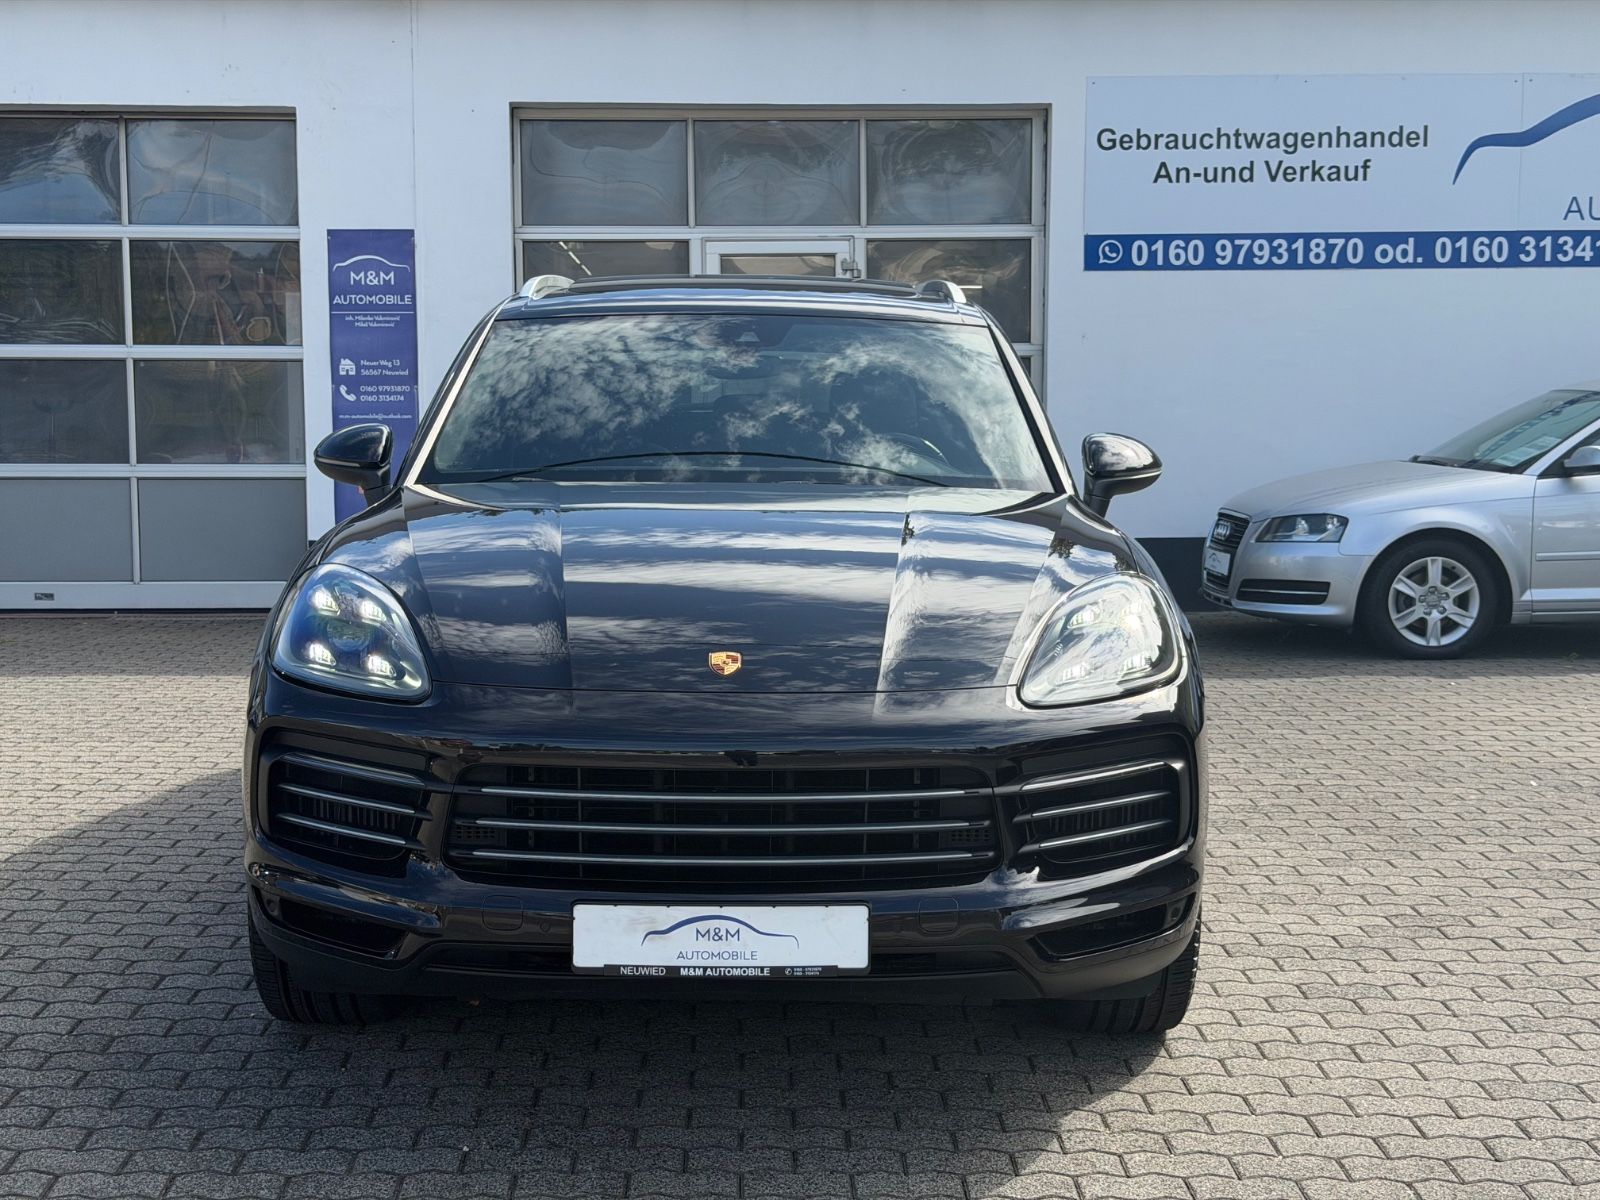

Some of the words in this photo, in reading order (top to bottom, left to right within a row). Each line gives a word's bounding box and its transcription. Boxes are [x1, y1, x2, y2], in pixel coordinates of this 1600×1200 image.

[1096, 125, 1428, 155] Gebrauchtwagenhandel
[1152, 160, 1255, 184] An-und
[1264, 159, 1372, 183] Verkauf
[1131, 239, 1205, 266] 0160
[1215, 237, 1364, 265] 97931870
[1374, 237, 1423, 263] od.
[1434, 236, 1509, 263] 0160
[1519, 235, 1600, 262] 3134
[350, 270, 395, 286] M&M
[333, 294, 412, 305] AUTOMOBILE
[379, 359, 393, 367] Weg
[382, 368, 409, 376] Neuwied
[360, 394, 378, 402] 0160
[695, 927, 741, 942] M&M
[676, 950, 758, 961] AUTOMOBILE
[620, 966, 667, 976] NEUWIED
[680, 967, 704, 976] M&M
[705, 967, 771, 976] AUTOMOBILE
